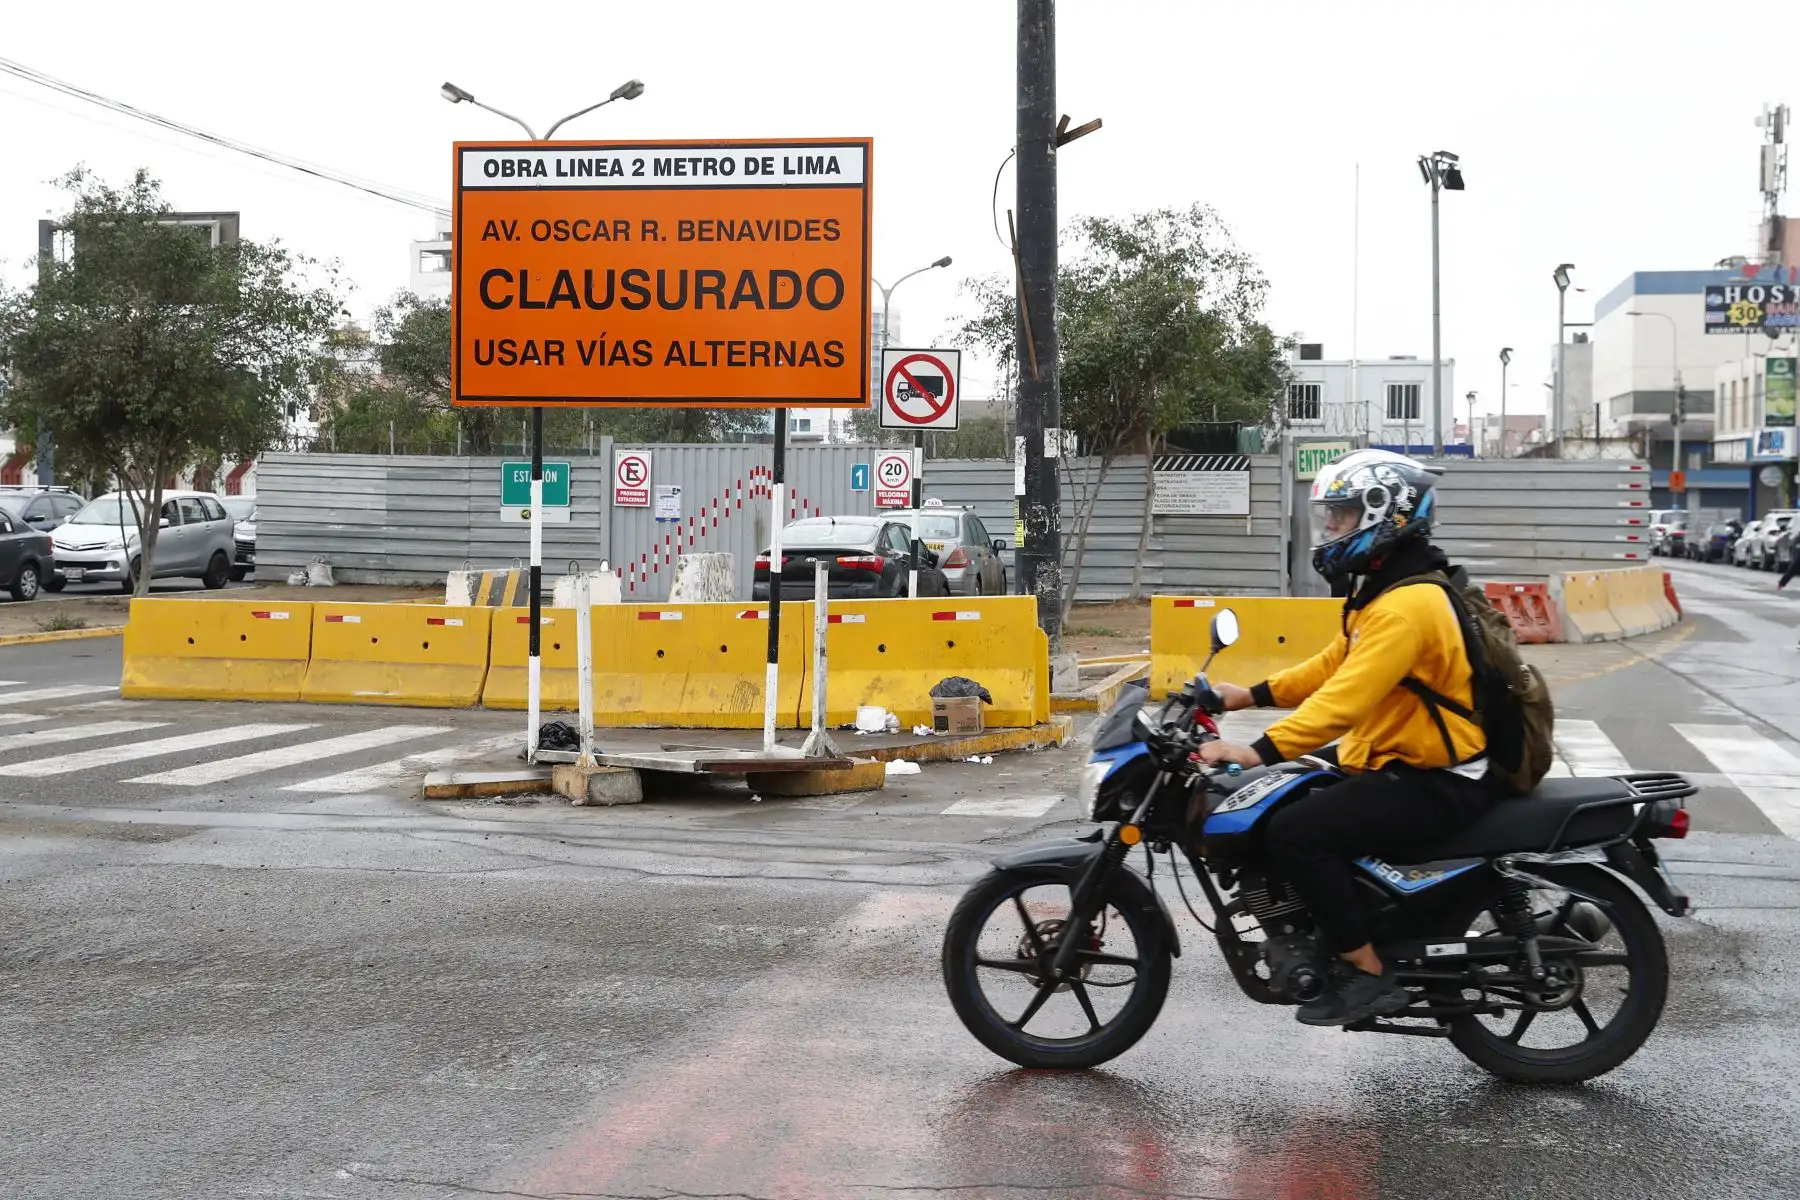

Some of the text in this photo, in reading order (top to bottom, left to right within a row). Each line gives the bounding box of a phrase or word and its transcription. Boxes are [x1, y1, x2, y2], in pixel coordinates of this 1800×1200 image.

[484, 156, 840, 177] OBRA LINEA 2 METRO DE LIMA
[482, 219, 841, 241] AV. OSCAR R. BENAVIDES
[480, 269, 844, 310] CLAUSURADO
[1735, 307, 1756, 321] 30
[475, 332, 844, 368] USAR VÍAS ALTERNAS
[514, 468, 558, 483] ESTIÓN
[855, 469, 863, 486] 1
[885, 463, 902, 476] 20
[882, 497, 904, 505] MÁXIMA
